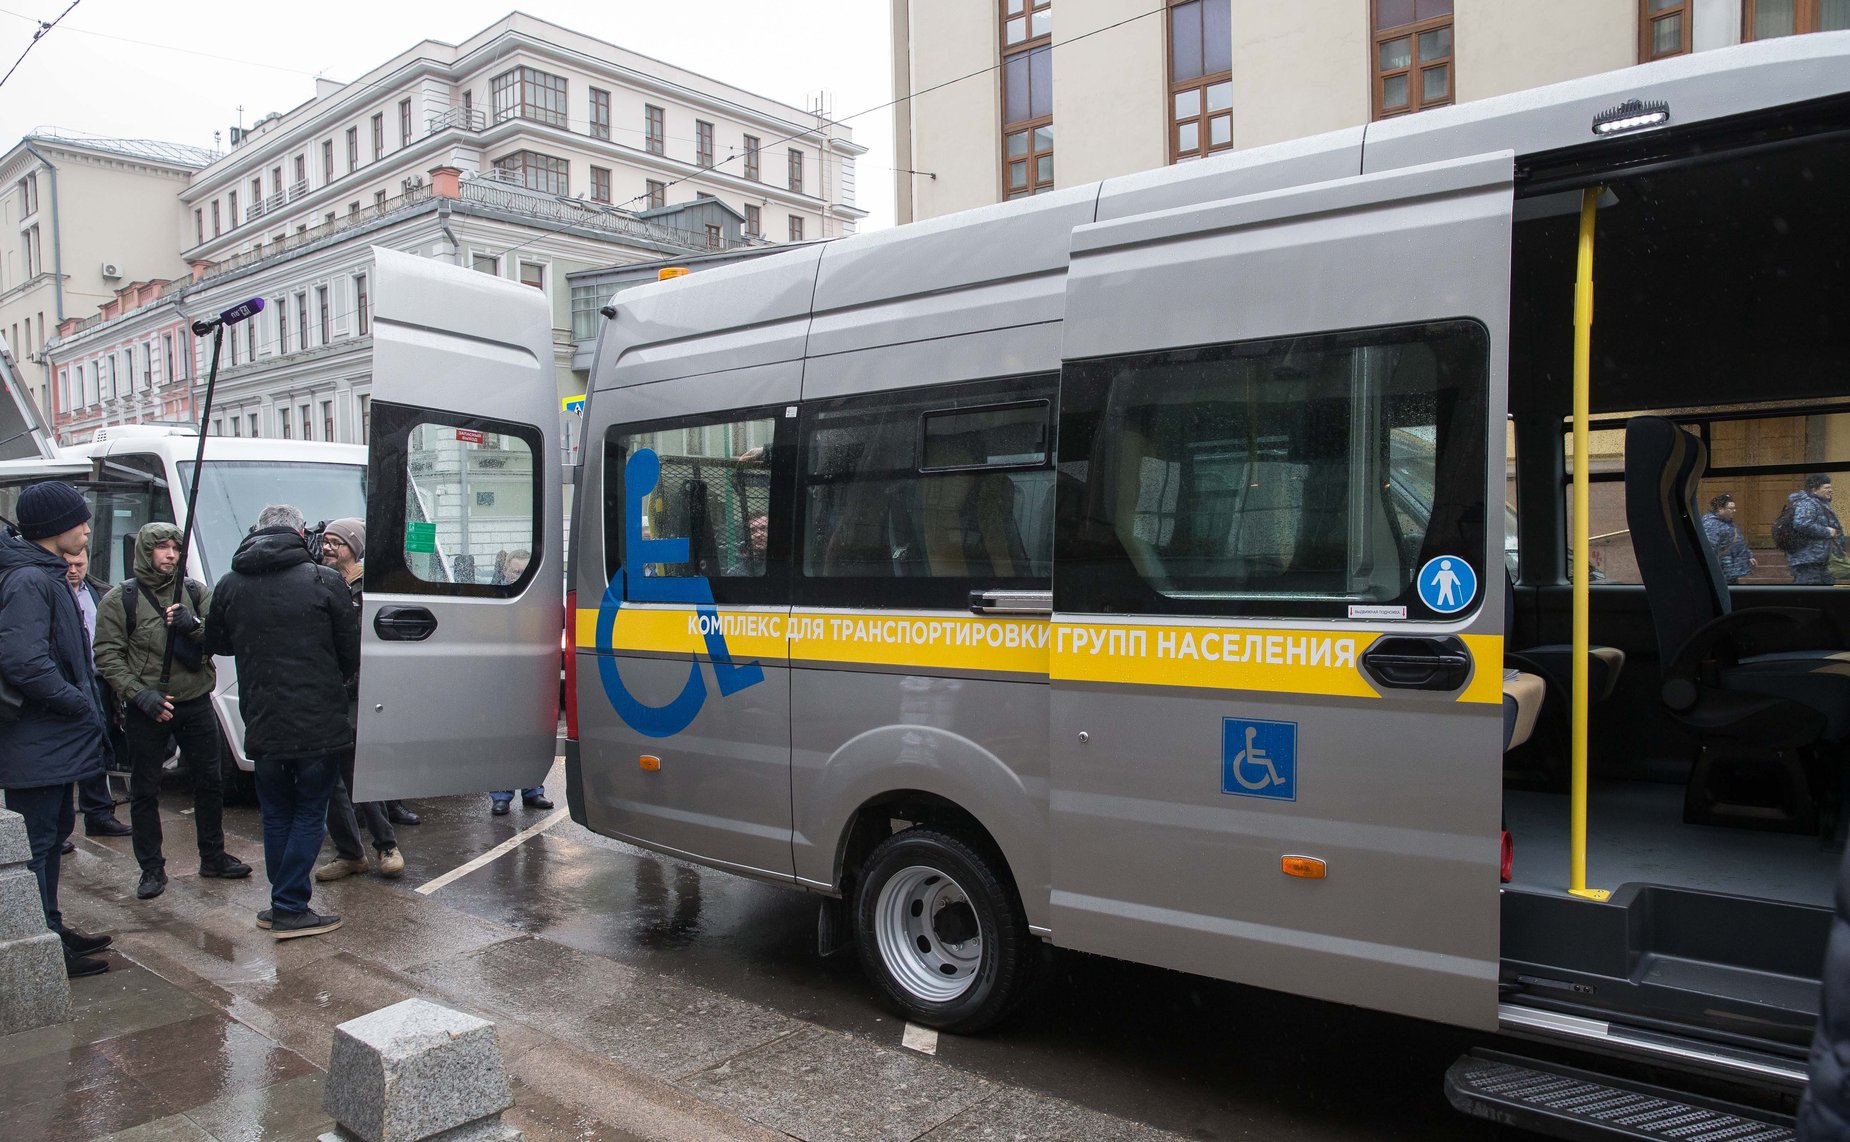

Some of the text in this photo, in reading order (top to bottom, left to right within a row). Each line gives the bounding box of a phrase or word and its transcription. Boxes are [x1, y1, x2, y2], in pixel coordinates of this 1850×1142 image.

[688, 615, 1355, 668] КОМПЛЕКС ДЛЯ ТРАНСПОРТИРОВКИ ГРУПП НАСЕЛЕНИЯ
